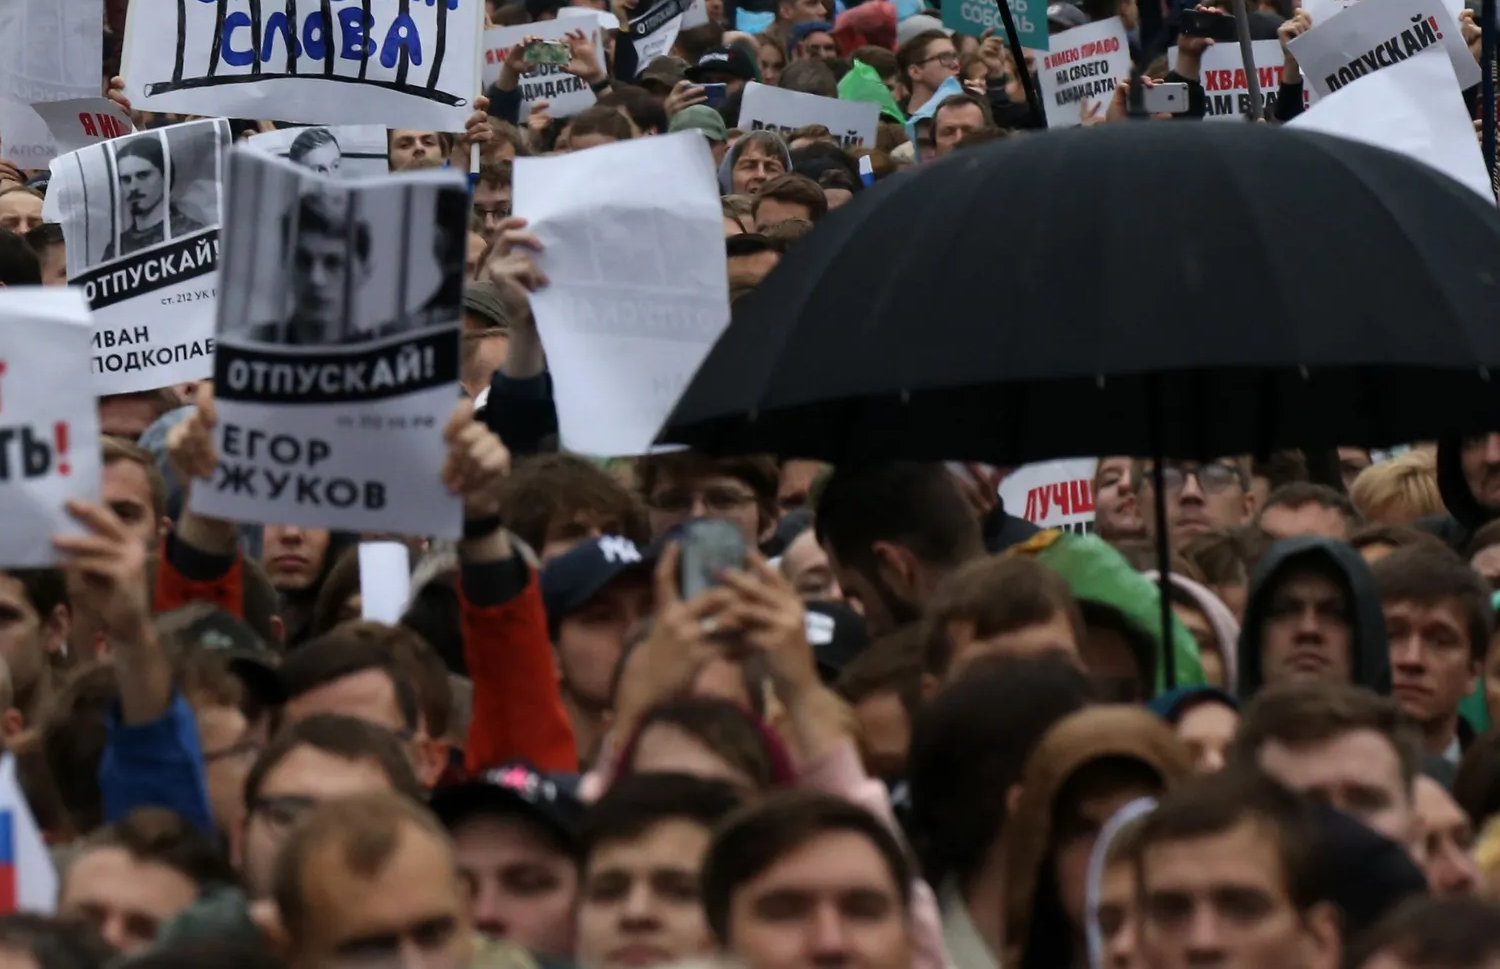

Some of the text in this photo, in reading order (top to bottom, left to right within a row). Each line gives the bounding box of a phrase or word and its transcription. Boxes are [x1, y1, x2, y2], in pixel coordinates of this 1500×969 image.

[221, 6, 422, 68] СЛОВА
[1080, 36, 1120, 59] ПРАВО
[1069, 60, 1109, 81] СВОЕГО
[1205, 65, 1285, 91] ХВАИТ
[1200, 94, 1233, 116] АМ
[78, 112, 98, 137] Я
[83, 238, 220, 303] ОТПУСКАЙ!
[176, 292, 193, 304] 212
[91, 337, 216, 374] ПОДКОПАЕ
[227, 345, 436, 394] ОТПУСКАЙ!
[222, 423, 331, 468] ЕГОР
[216, 460, 388, 511] ЖУКОВ
[1023, 479, 1097, 523] ЛУЧШ
